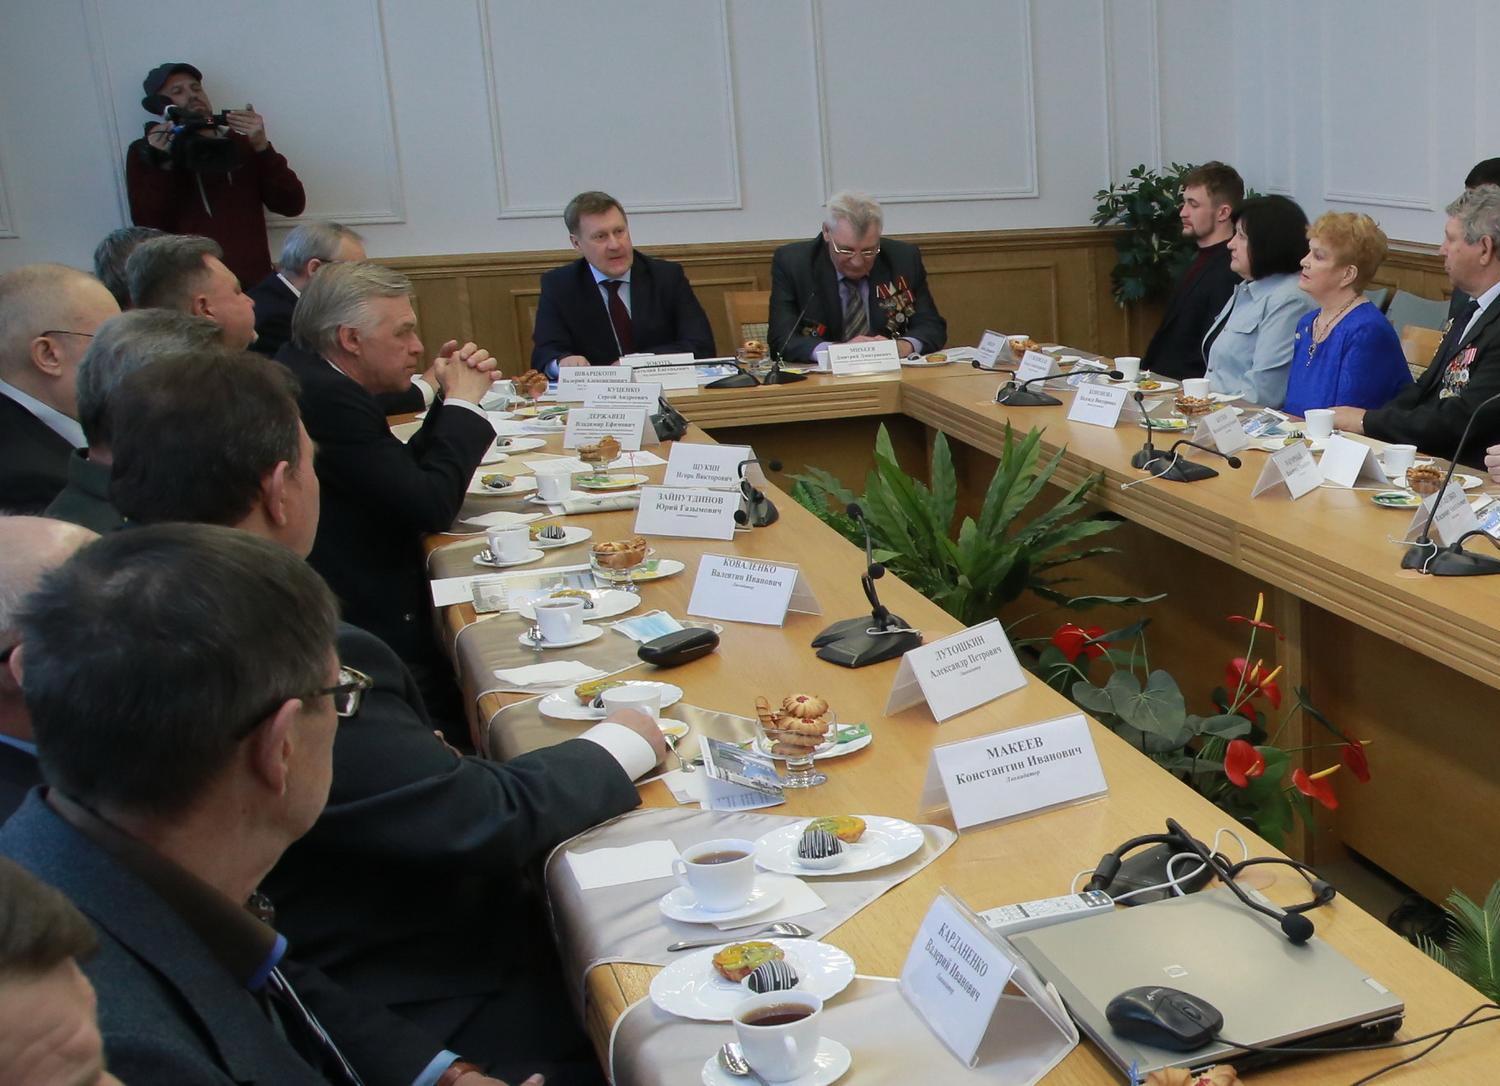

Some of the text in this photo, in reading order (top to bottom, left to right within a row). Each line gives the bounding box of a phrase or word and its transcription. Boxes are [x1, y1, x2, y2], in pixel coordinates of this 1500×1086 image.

[676, 471, 732, 482] Игорь Викторович
[655, 502, 678, 511] Юрий
[658, 492, 724, 504] ЗАЙНУТДИНОВ
[711, 568, 744, 581] Валентин
[745, 574, 782, 587] Иванович
[723, 558, 777, 574] КОВАЛЕНКО
[935, 635, 985, 661] ЛУТОШКИН
[929, 656, 969, 679] Александр
[969, 646, 1002, 666] Петрович
[985, 736, 1044, 760] МАКЕЕВ
[955, 746, 1082, 785] Константин Иванович
[938, 922, 989, 977] КАРДАНЕНКО
[924, 937, 952, 972] Валерий
[949, 962, 981, 1002] Иванович
